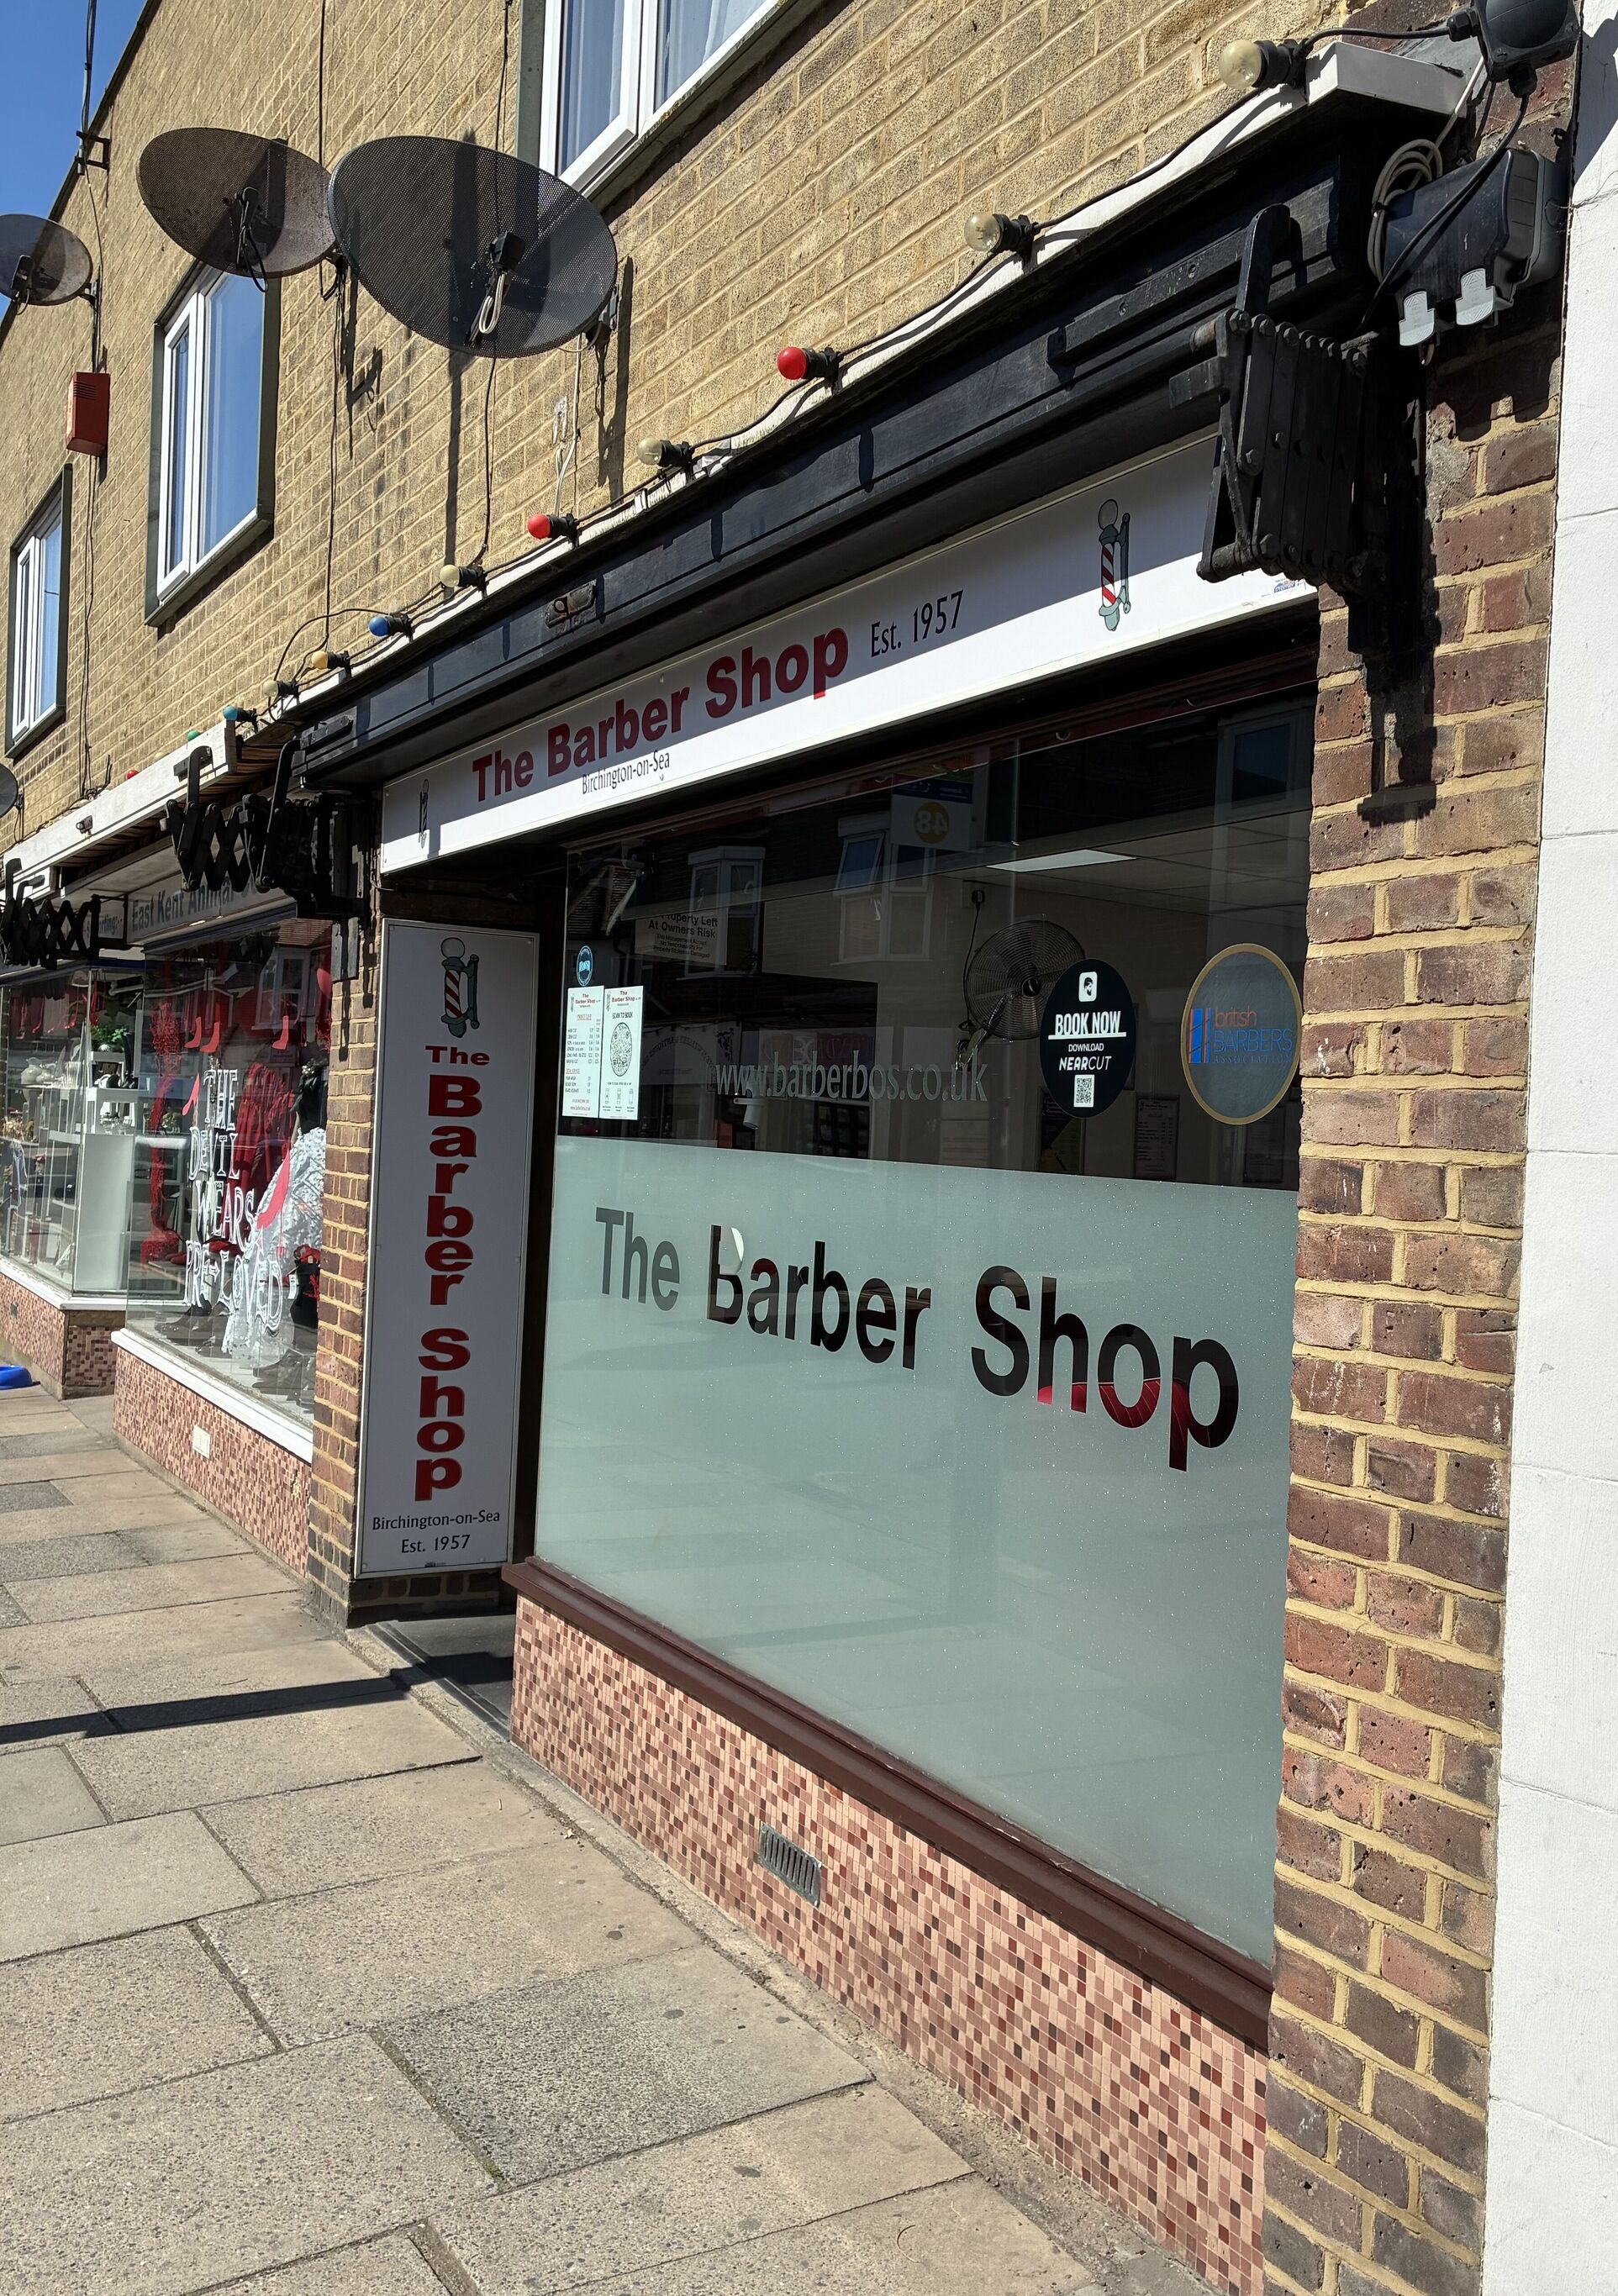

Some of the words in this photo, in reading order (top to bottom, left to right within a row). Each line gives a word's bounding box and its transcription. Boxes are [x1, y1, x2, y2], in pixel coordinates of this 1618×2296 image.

[870, 621, 902, 657] Est.
[913, 589, 963, 643] 1957
[472, 753, 534, 802] The
[547, 684, 690, 777] Barber
[704, 628, 849, 719] Shop
[582, 750, 671, 795] Birchington-on-Sea
[132, 899, 154, 931] East
[158, 890, 184, 924] Kent
[701, 916, 719, 927] Left
[648, 919, 659, 929] At
[661, 922, 694, 935] Owners
[698, 927, 716, 939] Risk
[1055, 1012, 1089, 1035] BOOK
[1093, 1010, 1121, 1034] NOW
[1215, 1004, 1257, 1027] british
[425, 1045, 491, 1066] The
[1068, 1042, 1104, 1052] DOWNLOAD
[1213, 1028, 1293, 1052] BARBERS
[716, 1048, 988, 1102] www.barberbos.co.uk
[1059, 1056, 1112, 1072] NEARCUT
[1215, 1055, 1292, 1063] ASSOCIATION
[203, 1069, 238, 1132] THE
[188, 1126, 240, 1181] DEVIL
[424, 1074, 482, 1306] Barber
[196, 1179, 255, 1258] WEARS
[595, 1207, 680, 1312] The
[706, 1224, 931, 1371] Barber
[971, 1265, 1239, 1472] Shop
[414, 1327, 471, 1502] Shop
[372, 1509, 500, 1531] Birchington-on-Sea
[401, 1538, 426, 1554] Est.
[434, 1534, 471, 1551] 1957
